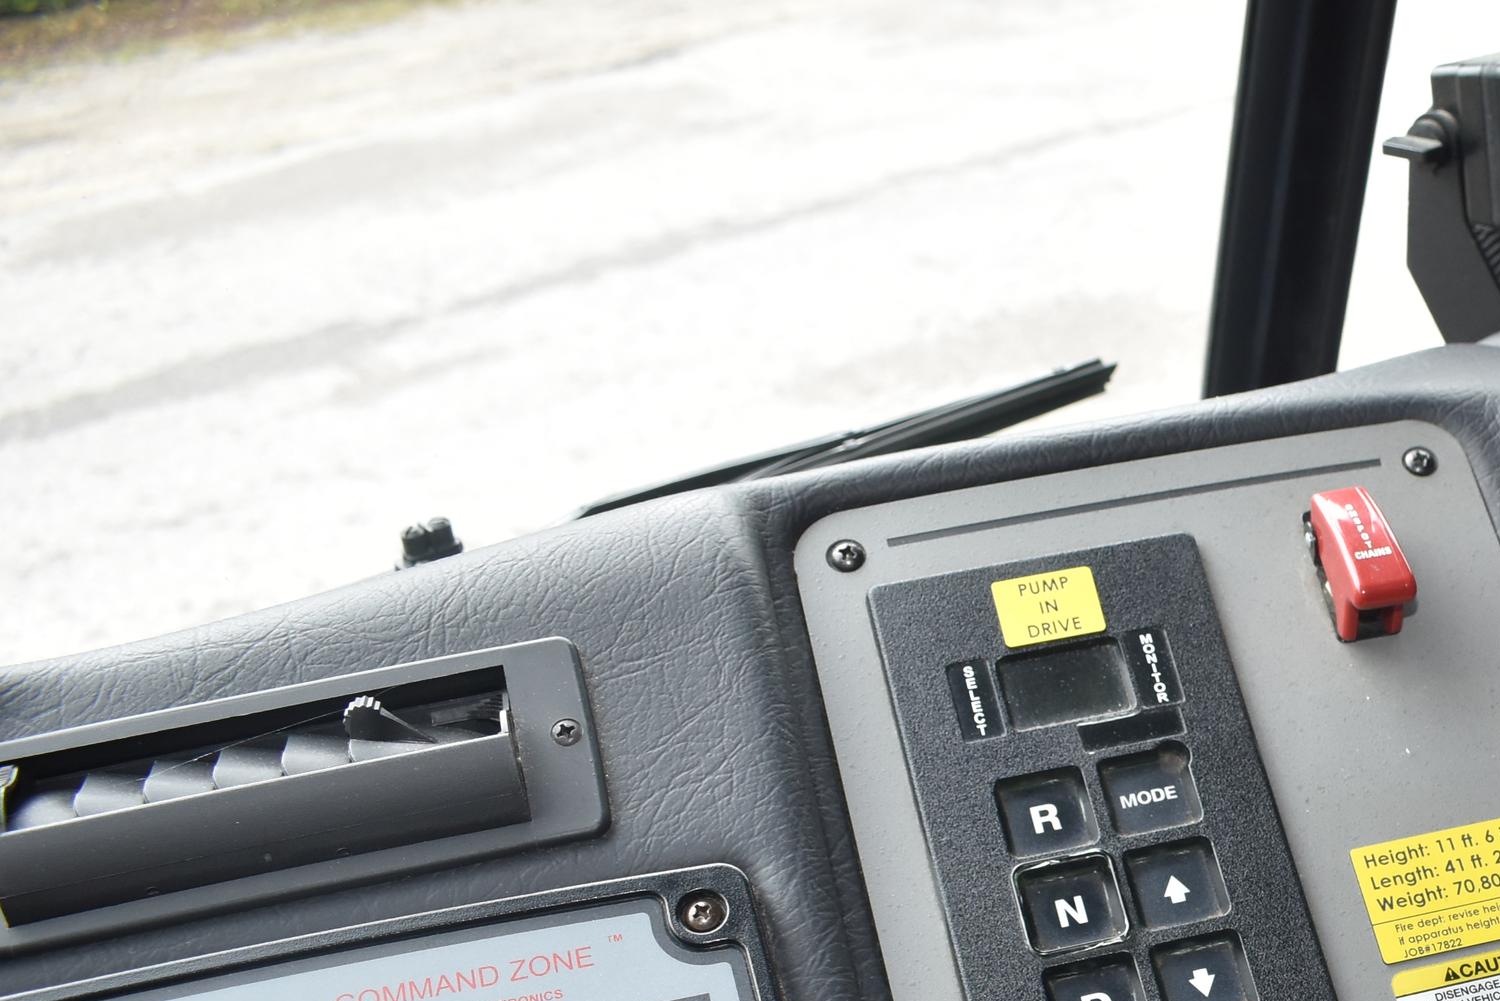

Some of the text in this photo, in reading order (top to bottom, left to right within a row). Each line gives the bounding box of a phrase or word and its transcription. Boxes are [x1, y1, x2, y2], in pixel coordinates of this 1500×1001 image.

[1018, 576, 1069, 597] PUMP
[1039, 599, 1058, 614] IN
[1027, 617, 1082, 638] DRIVE
[1139, 633, 1169, 704] MONITOR
[962, 665, 987, 736] SELECT
[1119, 785, 1178, 809] MODE
[1029, 803, 1062, 834] R
[1364, 844, 1430, 869] Height:
[1435, 837, 1454, 853] 11
[1461, 834, 1479, 847] ft.
[1485, 829, 1495, 843] 6
[1370, 865, 1439, 890] Length:
[1445, 859, 1464, 874] 41
[1471, 855, 1488, 869] ft.
[1054, 895, 1089, 928] N
[1376, 886, 1448, 912] Weight:
[1395, 922, 1413, 933] Fire
[1448, 907, 1480, 921] revise
[1398, 936, 1405, 945] if
[1408, 924, 1464, 945] apparatus
[1467, 916, 1500, 933] height
[509, 946, 595, 982] ZONE
[1434, 980, 1500, 1001] DISENGAGE
